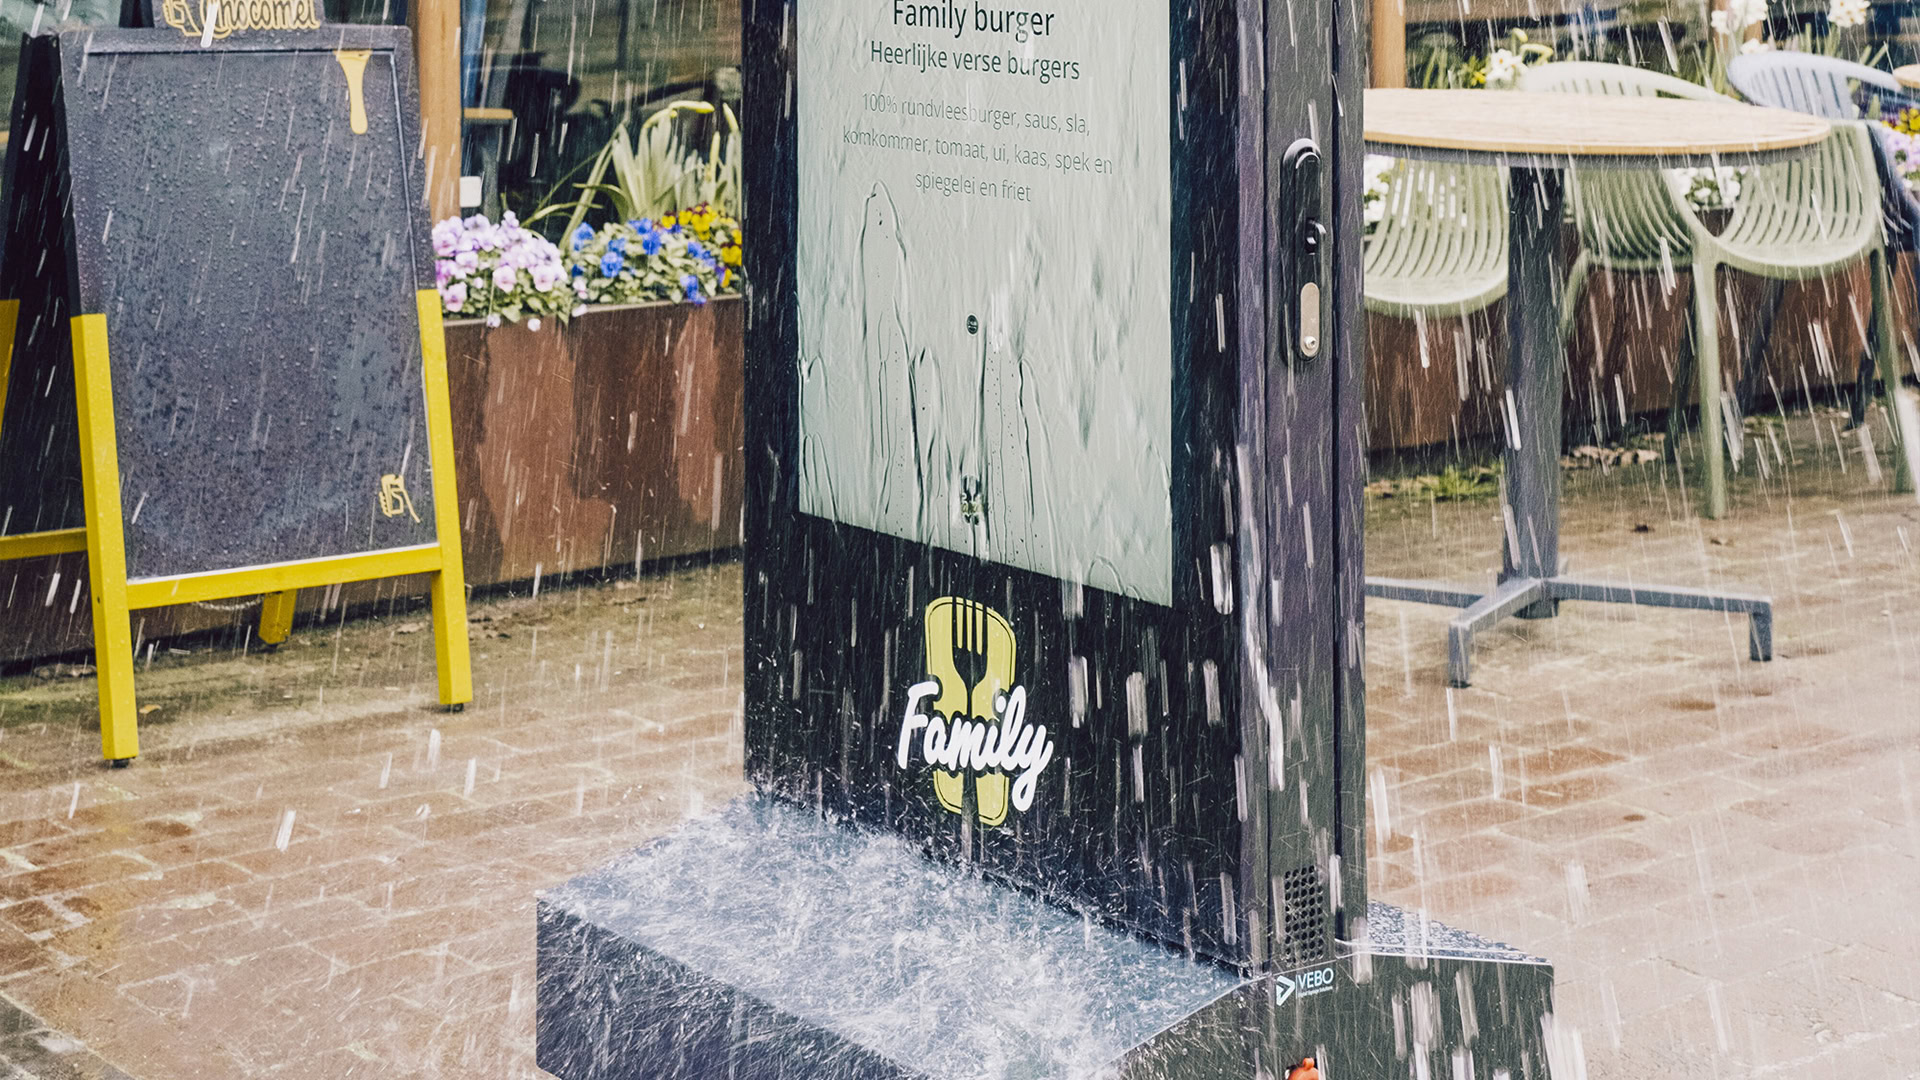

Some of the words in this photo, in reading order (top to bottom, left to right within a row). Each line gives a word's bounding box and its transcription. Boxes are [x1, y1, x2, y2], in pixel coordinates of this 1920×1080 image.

[893, 0, 967, 38] Family
[975, 1, 1054, 43] burger
[871, 41, 948, 73] Heerlijke
[952, 52, 1001, 73] verse
[1007, 50, 1080, 84] burgers
[863, 93, 897, 113] 100%
[902, 99, 1020, 130] rundvleesburger,
[1024, 113, 1061, 133] saus,
[1066, 113, 1090, 136] sla,
[843, 125, 931, 155] komkommer,
[936, 138, 988, 162] tomaat,
[993, 143, 1009, 165] ui,
[1014, 143, 1050, 169] kaas,
[1055, 152, 1090, 174] spek
[1094, 158, 1113, 174] en
[915, 171, 976, 197] spiegelei
[979, 181, 997, 197] en
[1002, 179, 1031, 202] friet
[898, 681, 1054, 811] Family
[1298, 967, 1334, 989] VEBO
